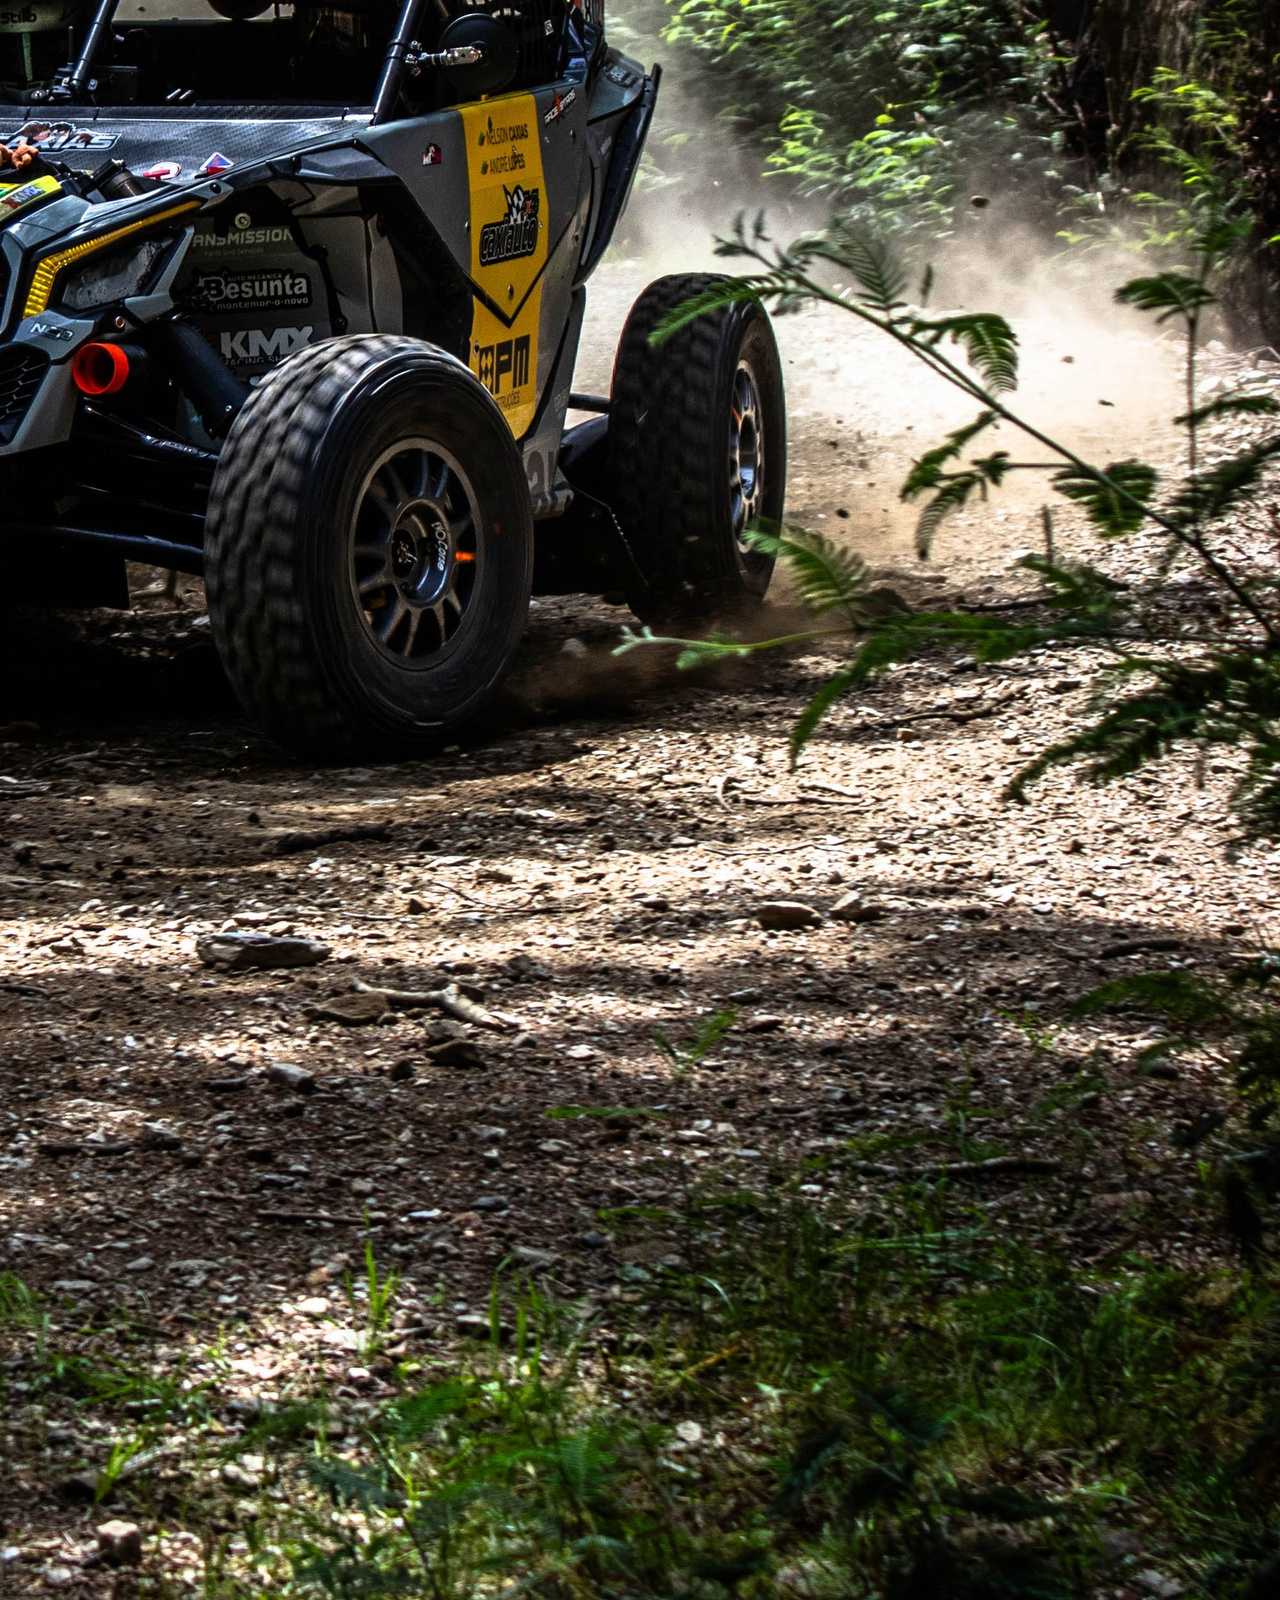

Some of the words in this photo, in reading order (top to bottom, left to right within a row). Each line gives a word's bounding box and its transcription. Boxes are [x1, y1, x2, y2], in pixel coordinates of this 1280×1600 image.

[486, 126, 508, 146] NELSON
[509, 123, 528, 141] CAXIAS
[508, 153, 525, 171] LOPES
[193, 229, 294, 247] ANSMISSION
[197, 273, 308, 301] Besunta
[217, 297, 309, 310] montemor-o-novo
[220, 325, 313, 359] KMX
[437, 540, 448, 571] Corse
